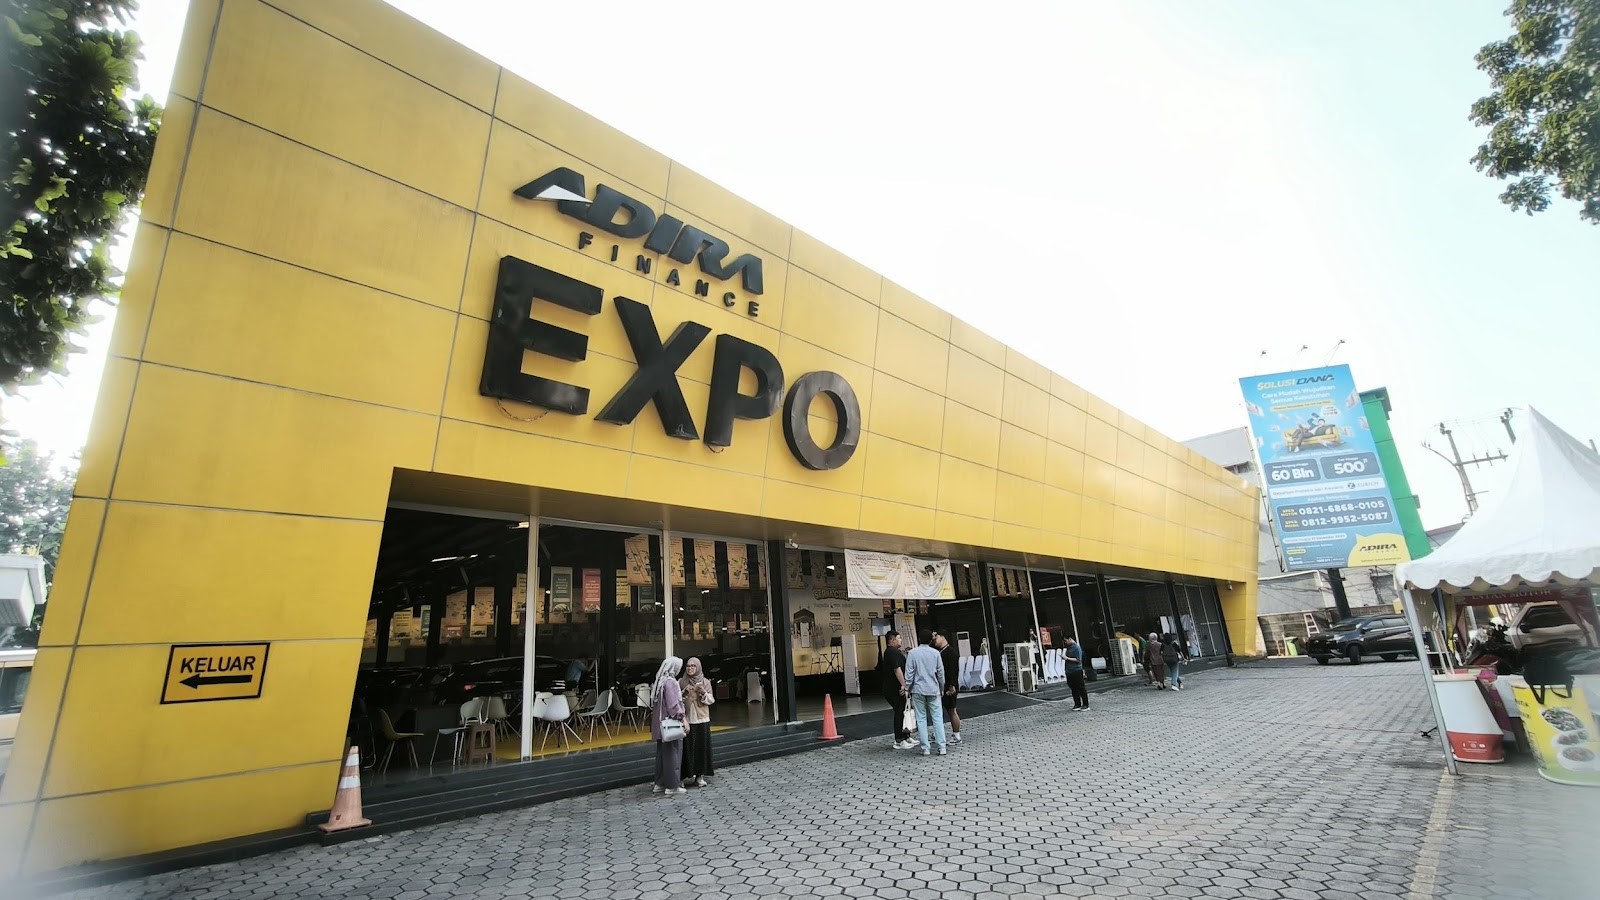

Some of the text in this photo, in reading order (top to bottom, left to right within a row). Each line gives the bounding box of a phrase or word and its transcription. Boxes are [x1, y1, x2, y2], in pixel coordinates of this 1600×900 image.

[512, 166, 764, 295] ADIRA
[578, 231, 760, 317] FINANCE
[480, 255, 862, 471] EXPO
[1257, 379, 1297, 391] SOLUSI
[1271, 468, 1315, 481] 60 Bln
[1333, 460, 1365, 475] 500
[1299, 501, 1385, 515] 0821-6868-0105
[1301, 512, 1388, 527] 0812-9952-5087
[1360, 543, 1398, 552] ADIRA
[180, 656, 256, 673] KELUAR
